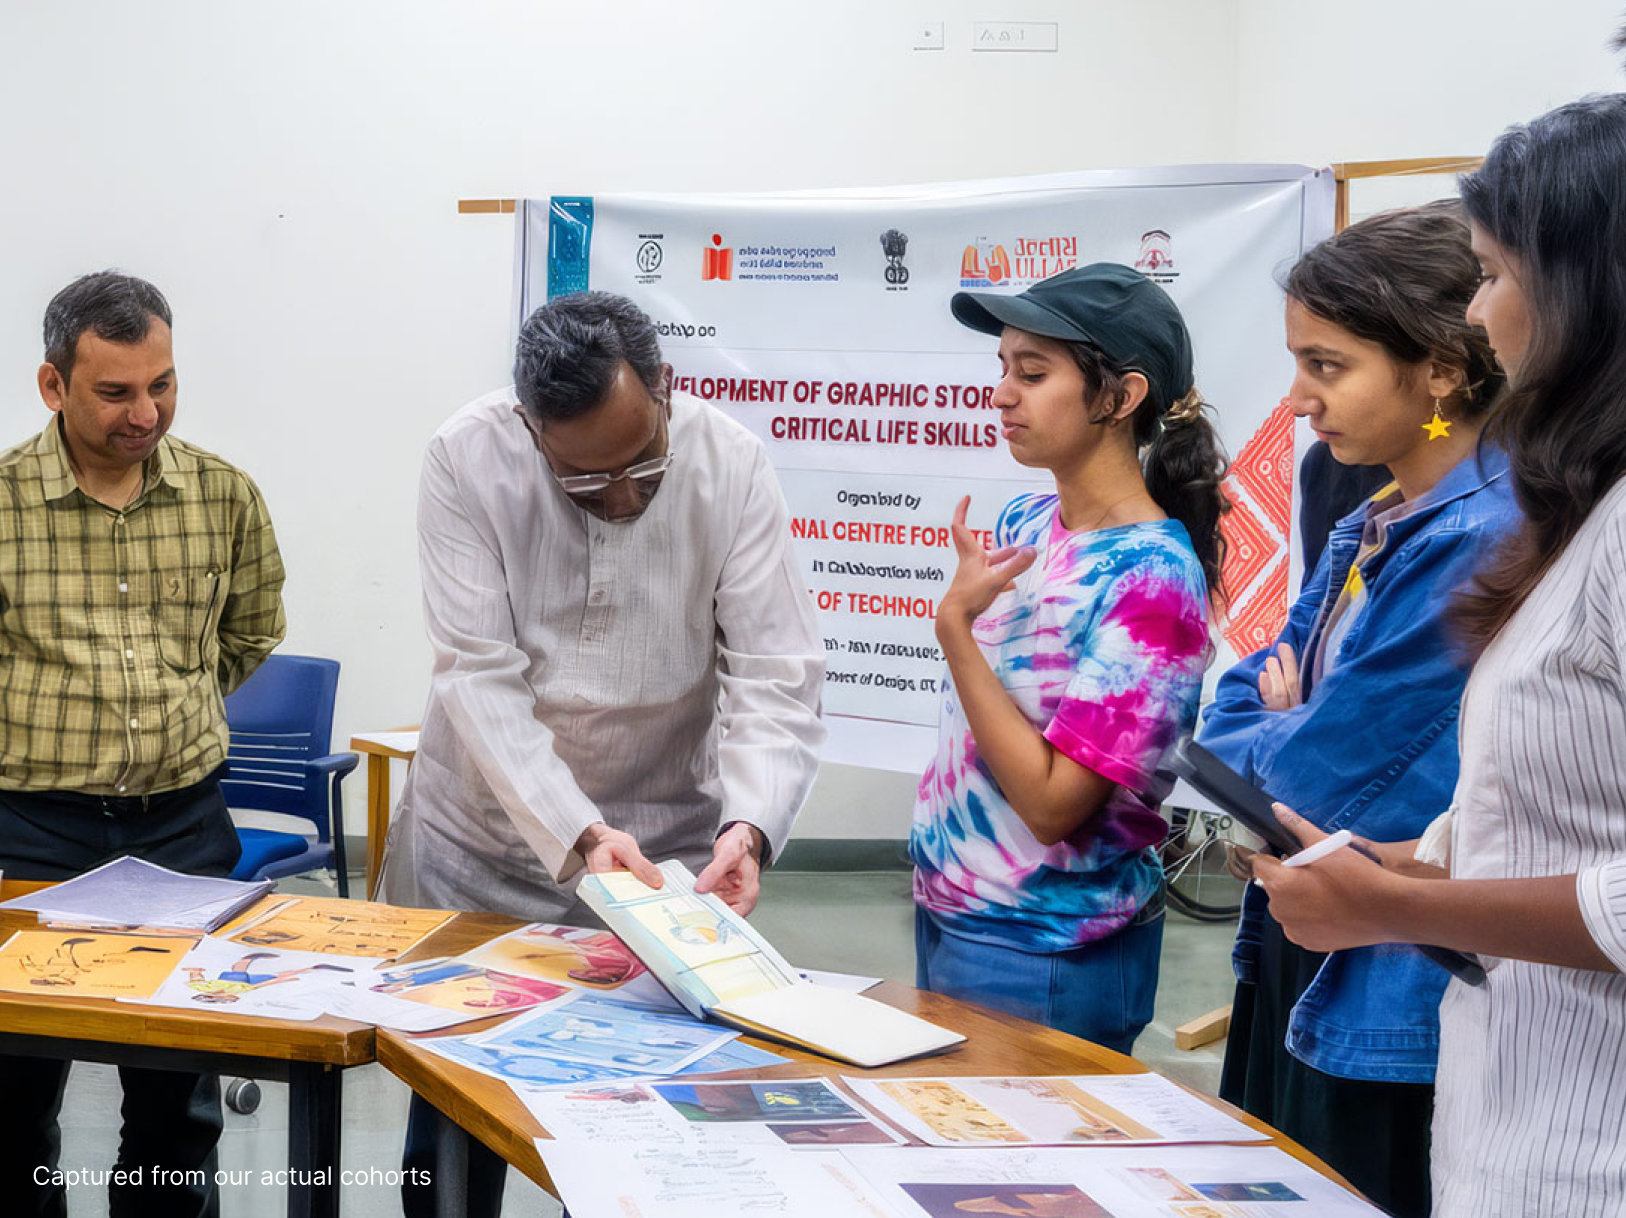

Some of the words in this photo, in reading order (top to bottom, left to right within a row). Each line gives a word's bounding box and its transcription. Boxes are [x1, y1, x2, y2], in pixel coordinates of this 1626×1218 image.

[793, 381, 823, 404] OF
[827, 382, 929, 408] GRAPHIC
[935, 385, 995, 409] STOR
[771, 416, 871, 443] CRITICAL
[877, 419, 919, 444] LIFE
[924, 422, 998, 448] SKILLS
[832, 521, 906, 545] CENTRE
[911, 526, 949, 548] FOR
[818, 590, 842, 611] OF
[847, 593, 938, 619] TECHNOL
